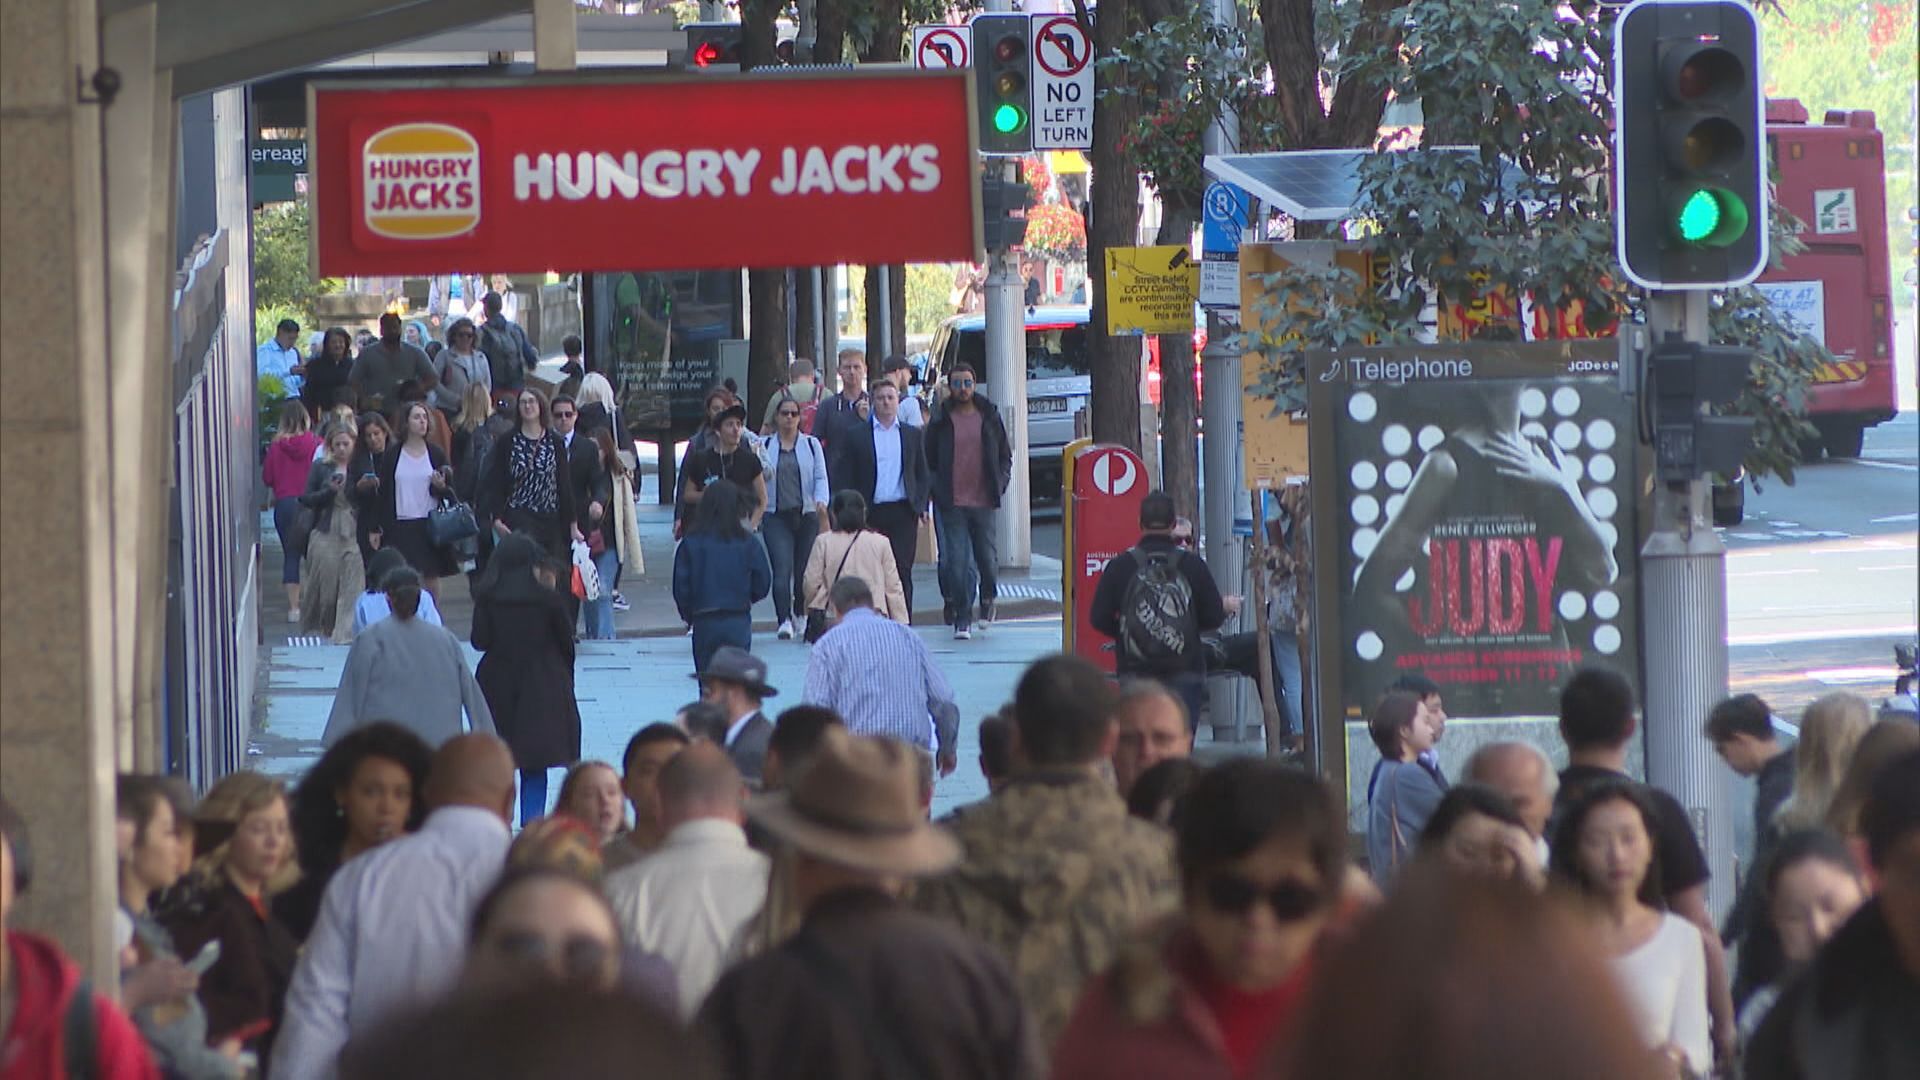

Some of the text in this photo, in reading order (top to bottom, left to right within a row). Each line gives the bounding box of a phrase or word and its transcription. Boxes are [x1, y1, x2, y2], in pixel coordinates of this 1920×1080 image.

[1047, 83, 1081, 102] NO
[1044, 108, 1086, 122] LEFT
[1042, 127, 1088, 142] TURN
[369, 158, 473, 179] HUNGRY
[513, 143, 941, 200] HUNGRY JACK'S
[1134, 276, 1160, 284] Street
[1124, 285, 1149, 294] CCTV
[1120, 294, 1188, 304] are continuously
[1140, 303, 1181, 312] recording
[1154, 311, 1169, 320] this
[619, 361, 645, 372] Keep
[675, 359, 685, 369] of
[688, 359, 710, 370] your
[1350, 356, 1473, 384] Telephone
[617, 372, 650, 382] money
[691, 370, 712, 380] your
[629, 382, 703, 391] tax return now
[1473, 522, 1537, 535] ZELLWEGER
[1408, 536, 1563, 637] JUDY
